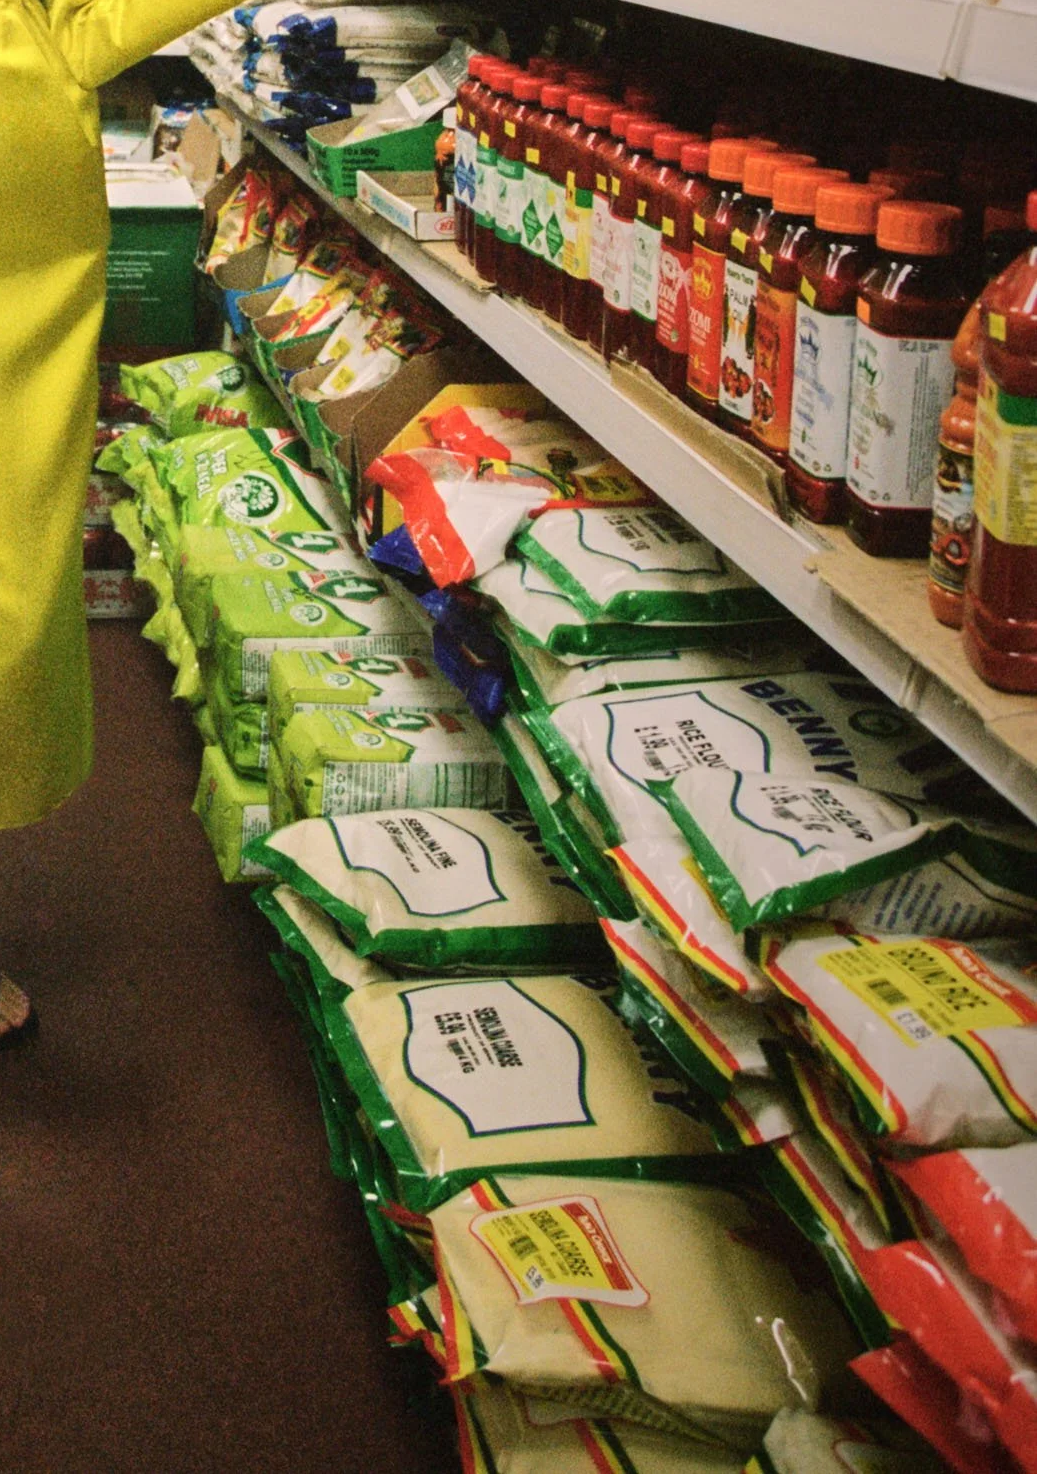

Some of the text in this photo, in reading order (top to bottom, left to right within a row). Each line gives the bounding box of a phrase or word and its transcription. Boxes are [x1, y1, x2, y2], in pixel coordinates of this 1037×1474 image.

[730, 286, 749, 306] PALM
[675, 719, 704, 744] RICE
[740, 679, 859, 782] BENNY
[404, 817, 458, 869] SEMOLINA FINE
